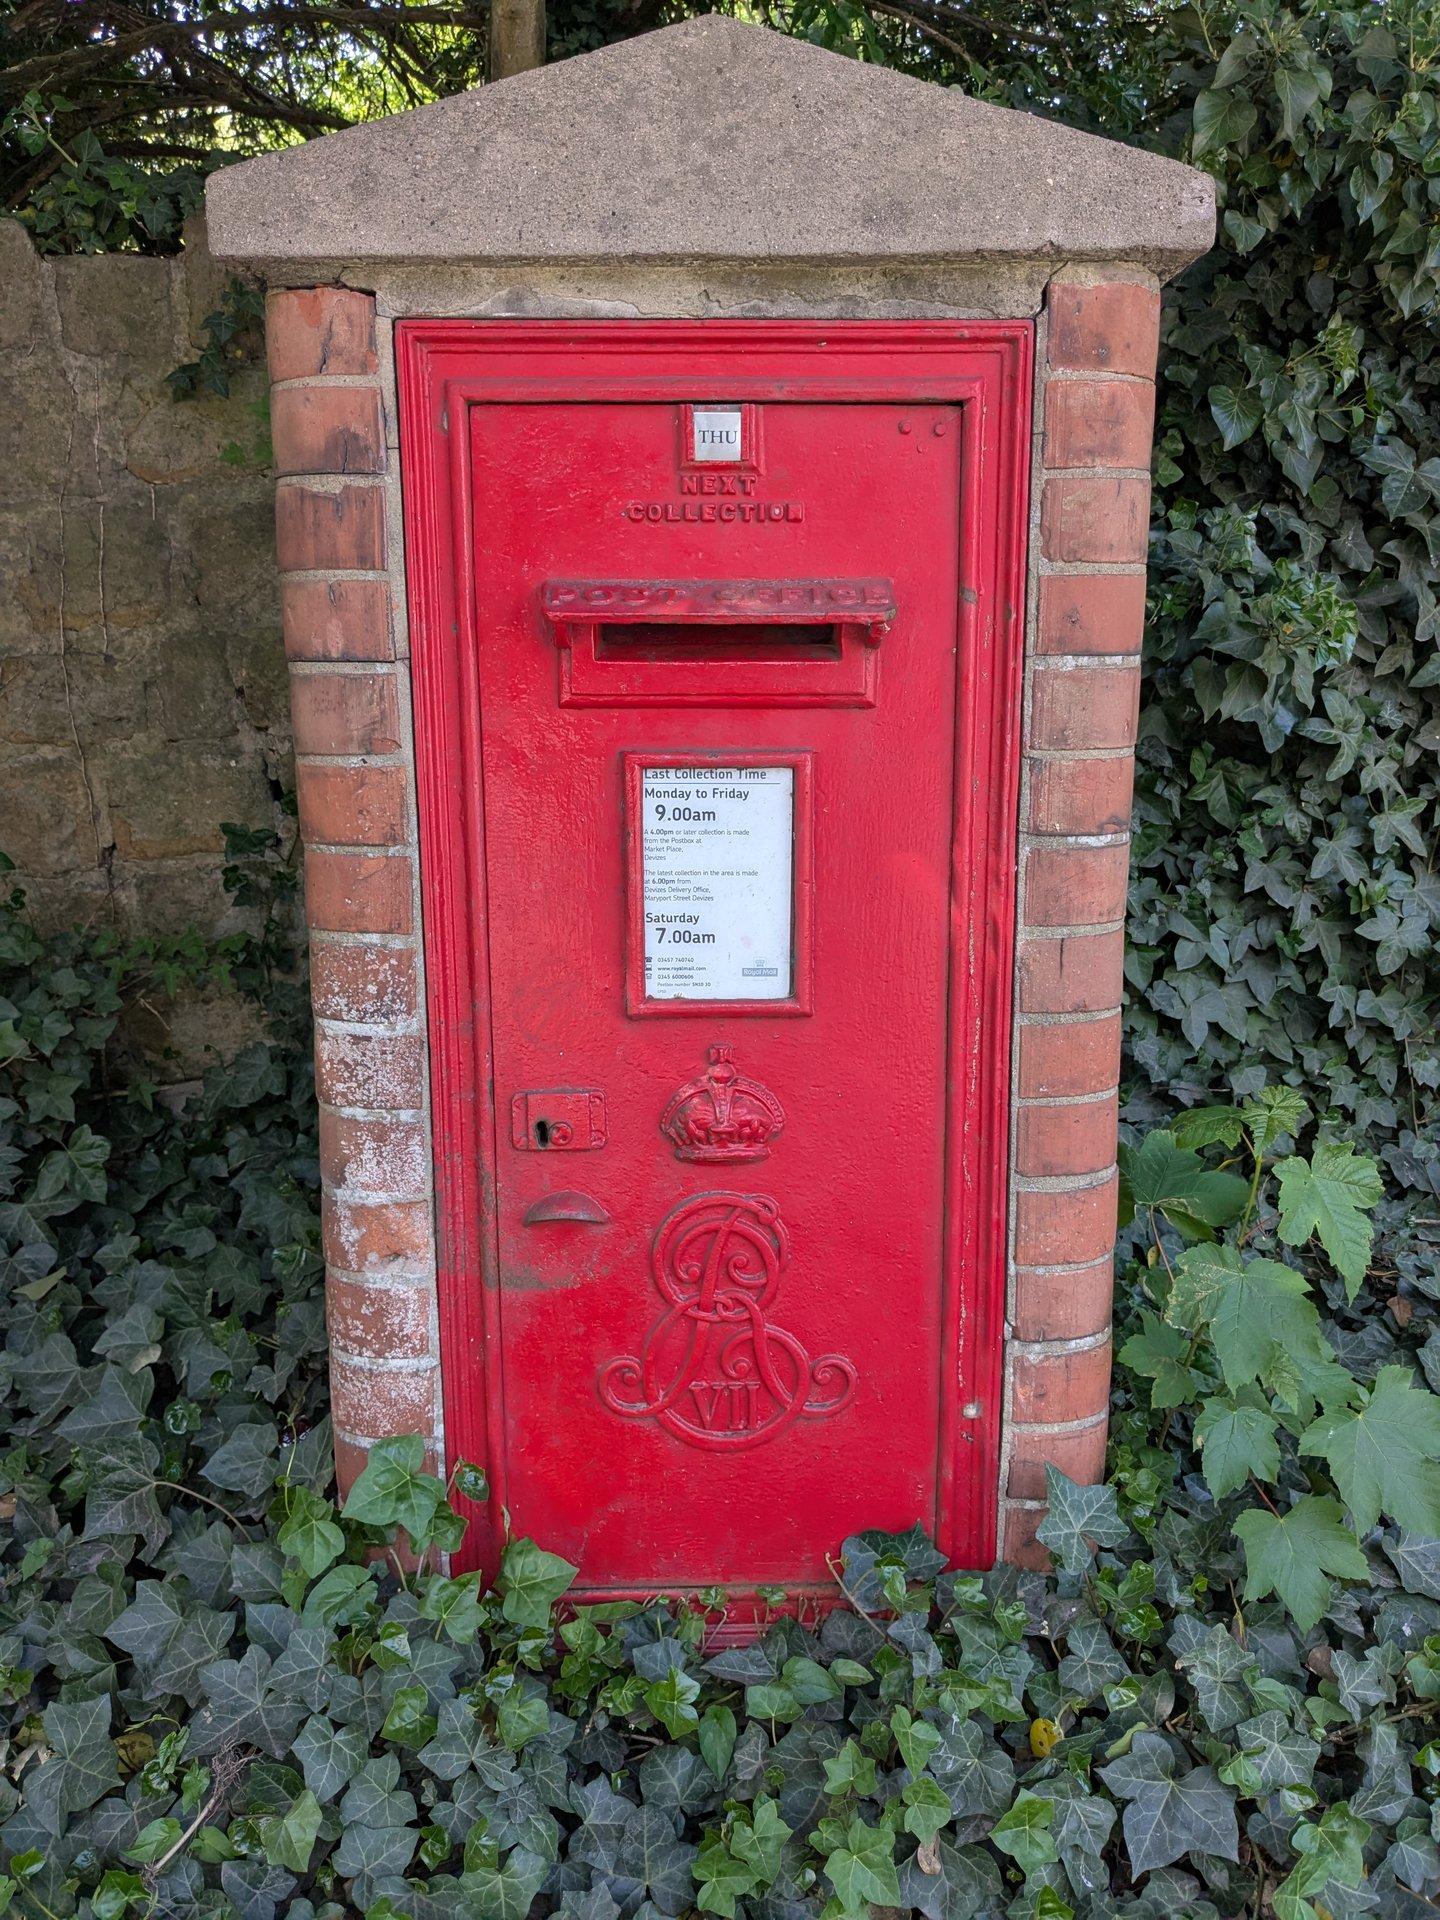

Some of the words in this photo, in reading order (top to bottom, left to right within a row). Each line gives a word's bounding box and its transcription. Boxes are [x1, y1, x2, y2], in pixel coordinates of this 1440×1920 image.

[698, 429, 738, 444] THU
[680, 474, 758, 496] NEXT
[627, 503, 805, 523] COLLECTION
[644, 768, 670, 779] Last
[674, 768, 733, 779] Collection
[736, 768, 767, 779] Time
[644, 788, 692, 800] Monday
[696, 788, 708, 798] to
[712, 788, 750, 801] Friday
[654, 804, 716, 822] 9.00am
[645, 912, 700, 925] Saturday
[655, 928, 716, 944] 7.00am
[688, 1381, 761, 1430] VII
